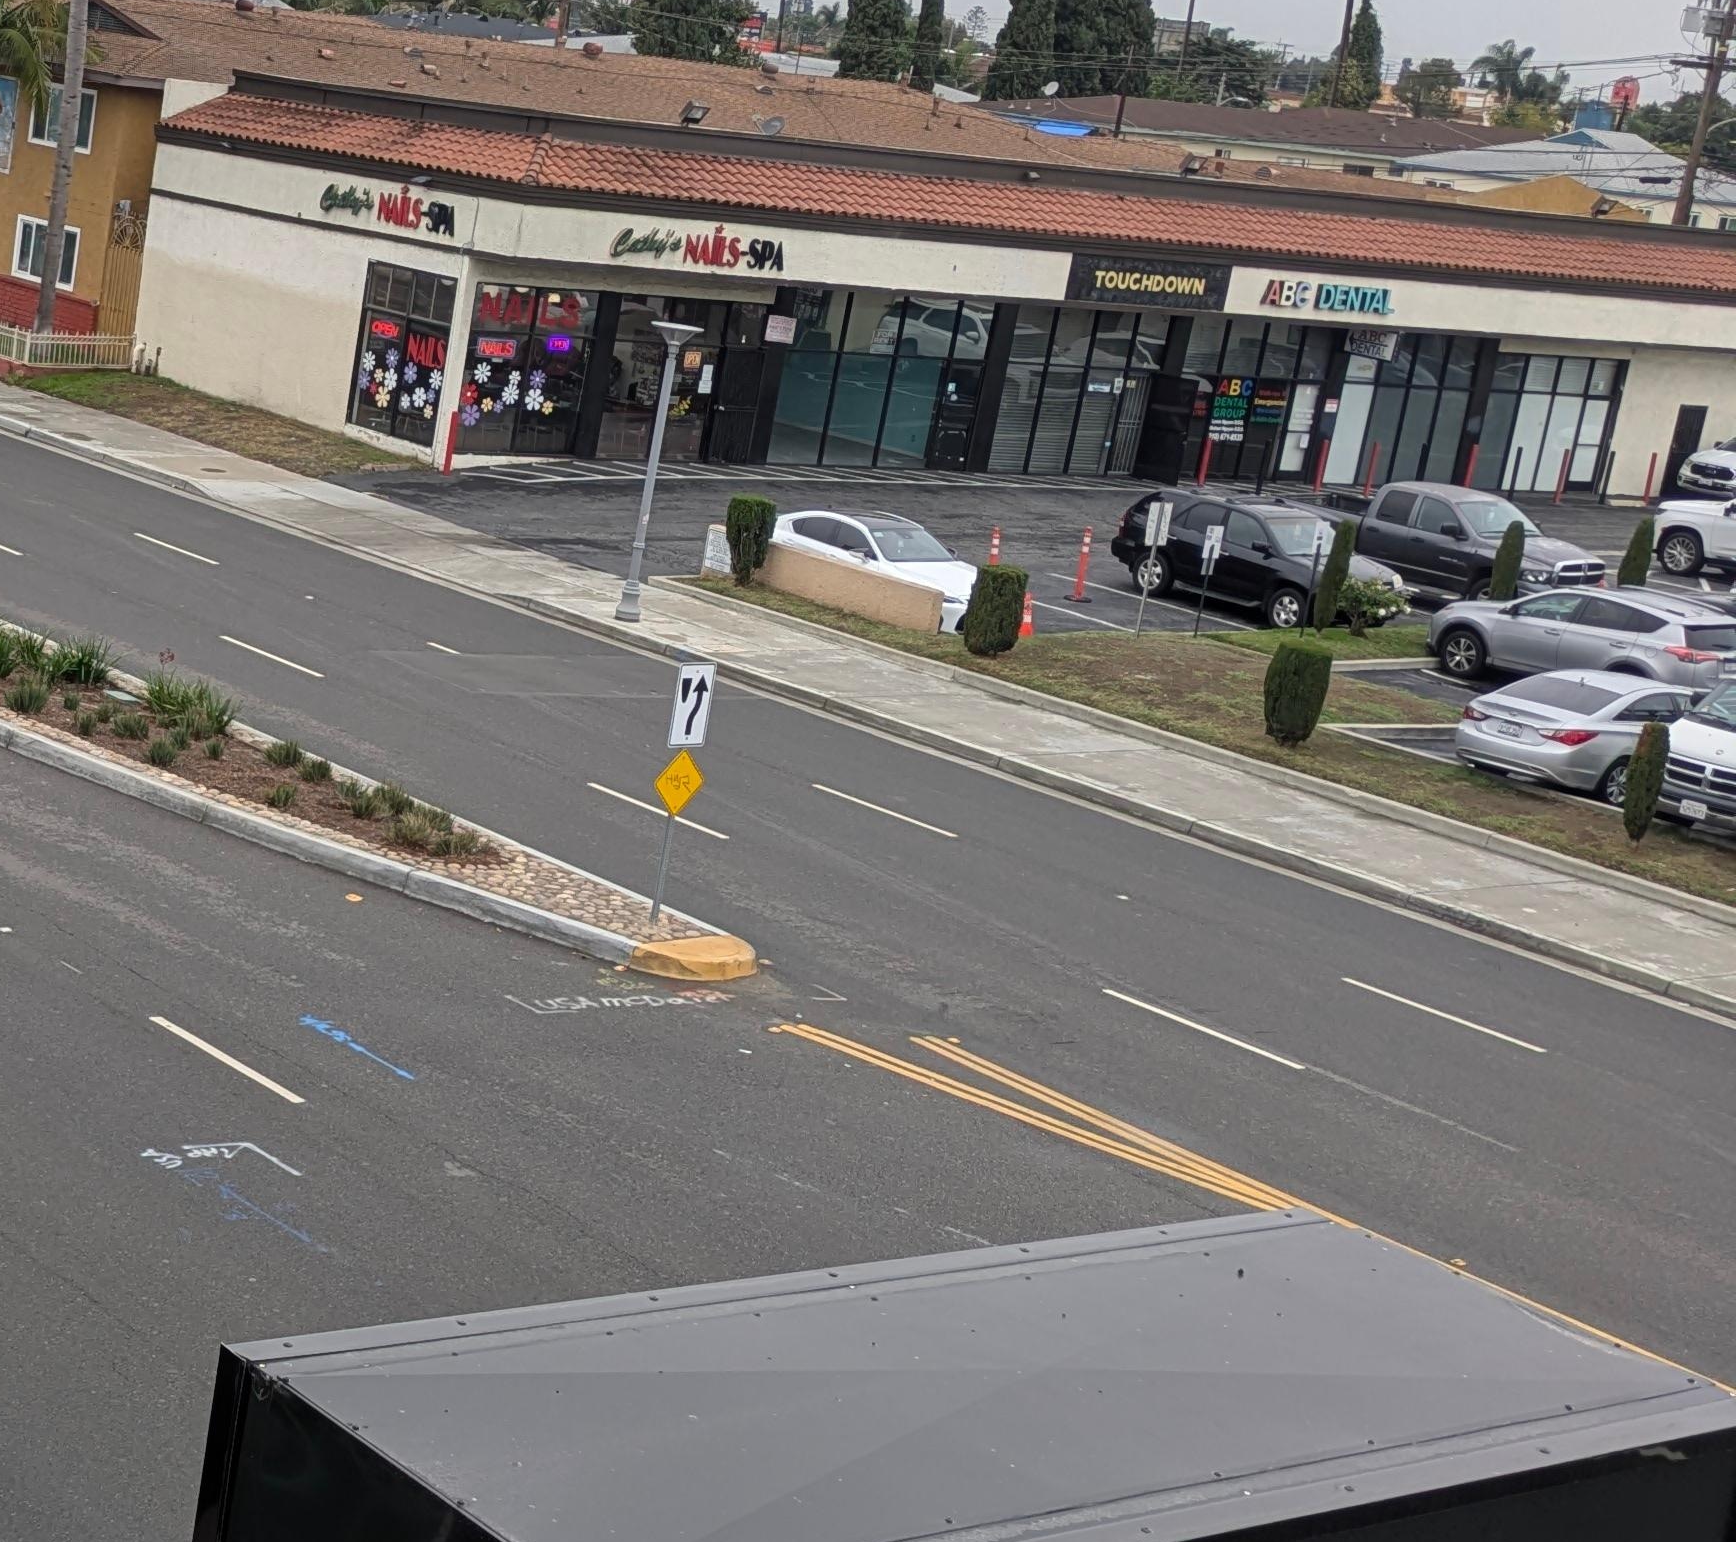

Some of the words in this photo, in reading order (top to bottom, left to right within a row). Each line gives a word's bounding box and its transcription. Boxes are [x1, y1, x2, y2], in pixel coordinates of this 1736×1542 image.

[1094, 270, 1206, 295] TOUCHDOWN
[1264, 279, 1313, 307] ABC
[1318, 284, 1395, 315] DENTAL
[478, 291, 582, 328] NAILS
[371, 319, 400, 338] OPEN
[1357, 330, 1387, 342] ABC
[406, 332, 447, 370] NAILS
[480, 340, 514, 356] NAILS
[1351, 341, 1386, 358] DENTAL
[1218, 378, 1254, 396] ABC
[1214, 397, 1248, 408] DENTAL
[1213, 408, 1246, 418] GROUP
[534, 996, 600, 1010] USA
